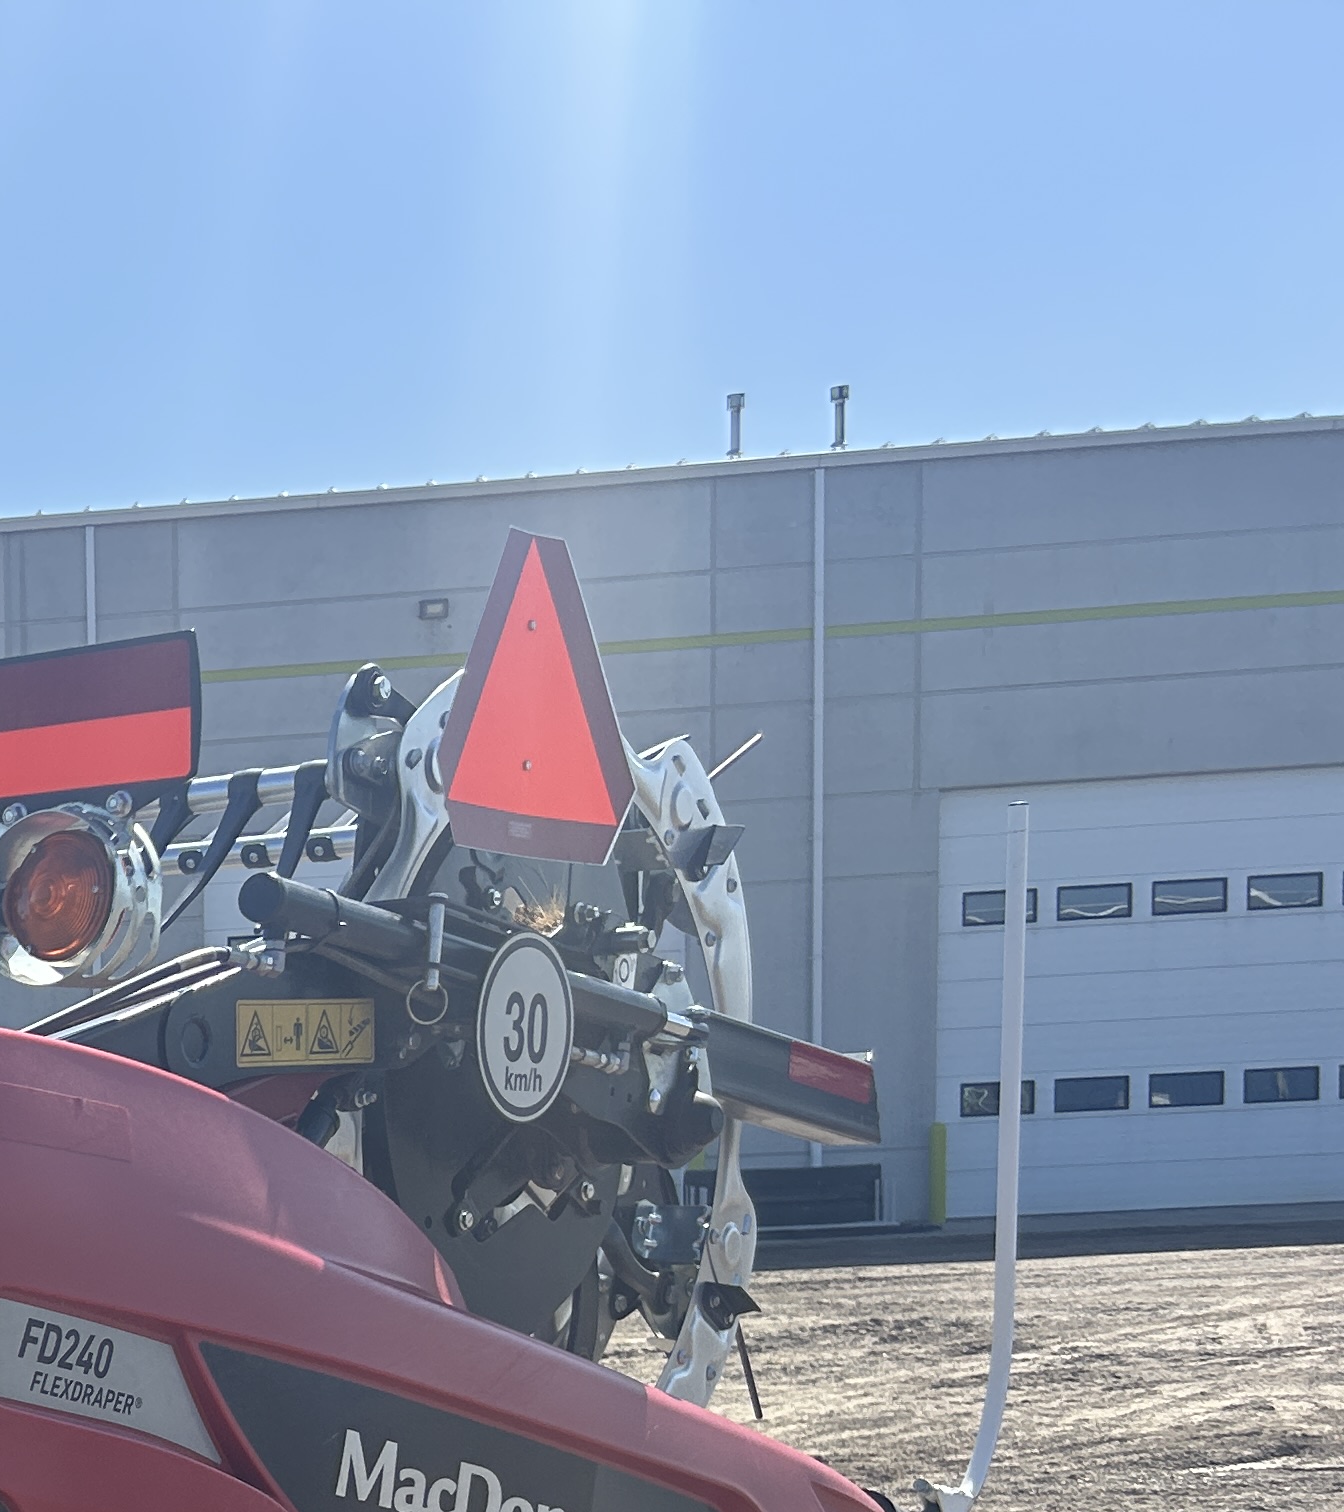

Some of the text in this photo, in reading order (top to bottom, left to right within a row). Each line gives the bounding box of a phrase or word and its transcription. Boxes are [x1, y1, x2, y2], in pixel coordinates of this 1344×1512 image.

[503, 991, 549, 1064] 30
[504, 1066, 543, 1092] km/h
[17, 1317, 114, 1379] FD240
